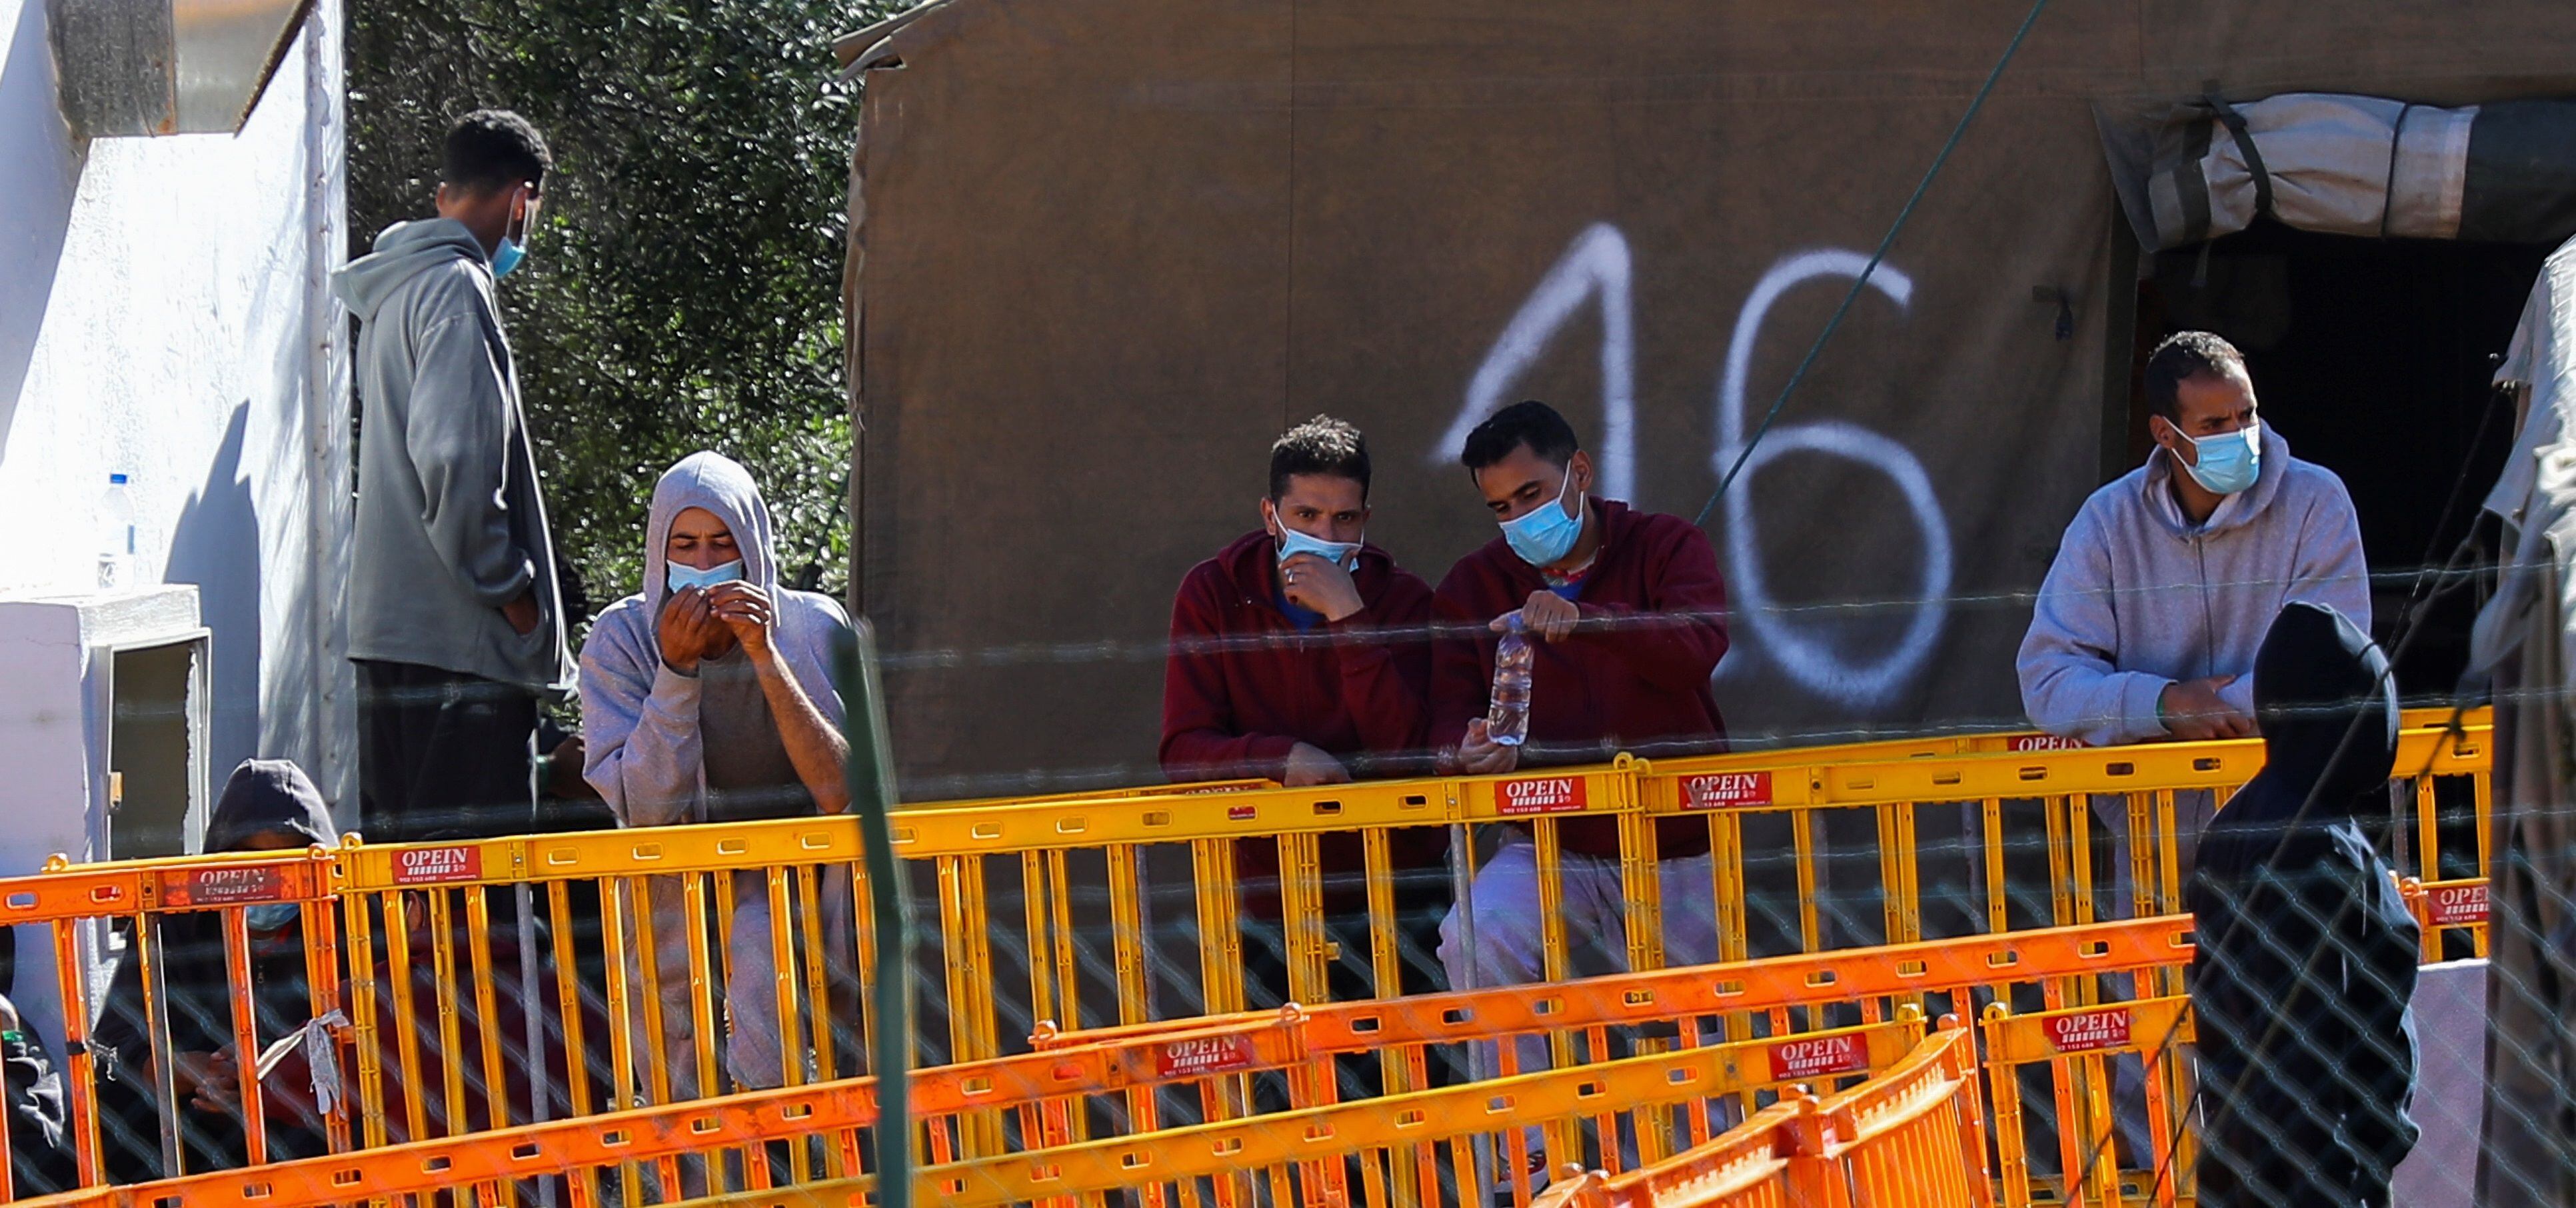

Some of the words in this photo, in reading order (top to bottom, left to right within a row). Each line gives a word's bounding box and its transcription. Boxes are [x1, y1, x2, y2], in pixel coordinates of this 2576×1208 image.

[1432, 222, 1953, 708] 16
[1506, 778, 1574, 798] OPEIN
[1691, 773, 1758, 792] OPEIN
[402, 847, 469, 867] OPEIN
[2056, 1011, 2127, 1034] OPEIN
[1167, 1035, 1238, 1059] OPEIN
[1781, 1035, 1852, 1061] OPEIN
